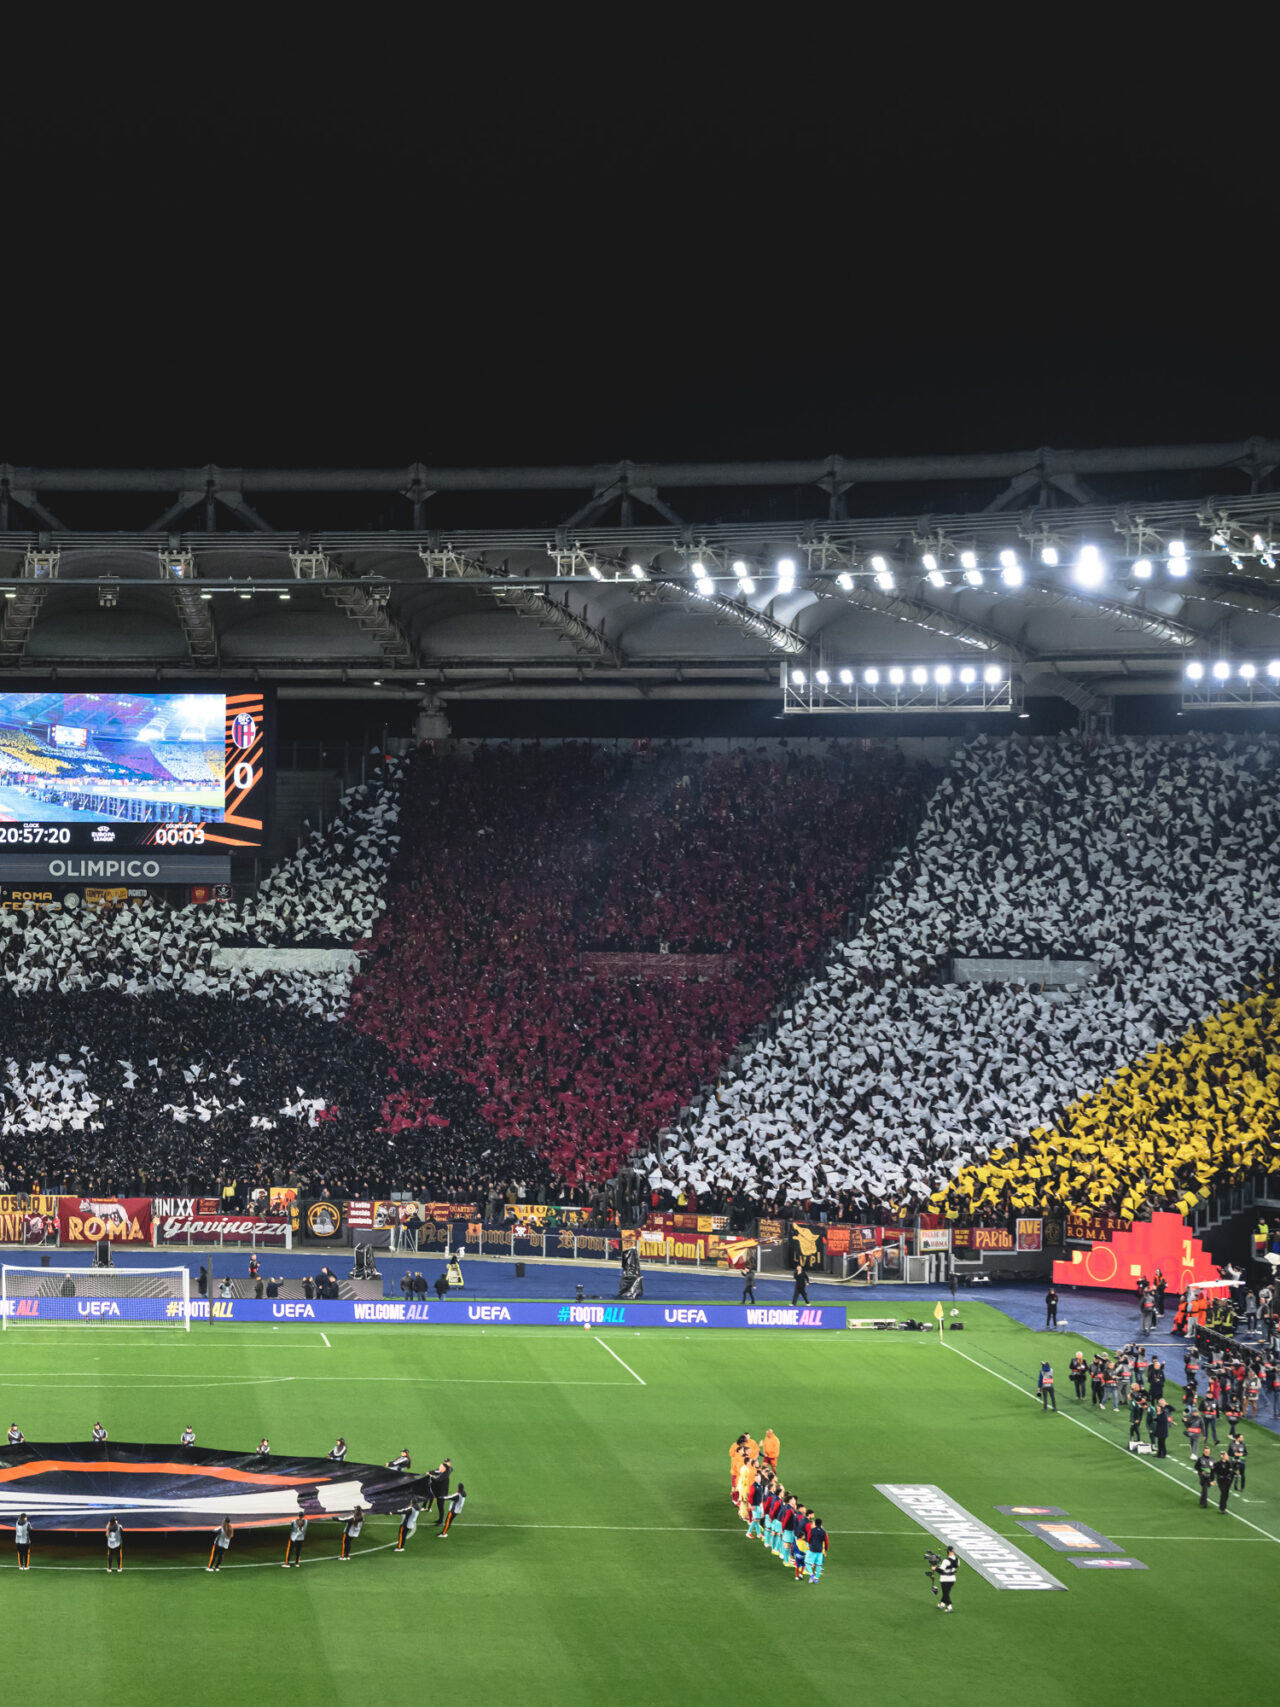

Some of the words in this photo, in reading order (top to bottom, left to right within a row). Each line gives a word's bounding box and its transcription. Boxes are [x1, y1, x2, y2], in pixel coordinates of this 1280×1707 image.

[234, 762, 253, 789] 0
[155, 829, 205, 844] 00:03
[49, 860, 160, 877] OLIMPICO
[12, 891, 53, 900] ROMA
[69, 1215, 144, 1240] ROMA
[163, 1217, 289, 1239] Giovinezza
[1019, 1221, 1040, 1234] AVE
[1067, 1227, 1107, 1240] ROMA
[16, 1300, 39, 1316] ALL
[78, 1302, 120, 1315] UEFA
[273, 1303, 315, 1318] UEFA
[354, 1303, 405, 1319] WELCOME
[406, 1304, 429, 1319] ALL
[468, 1306, 511, 1320] UEFA
[558, 1306, 625, 1323] #FOOTBALL
[665, 1309, 708, 1323] UEFA
[746, 1309, 798, 1325] WELCOME
[799, 1310, 822, 1326] ALL
